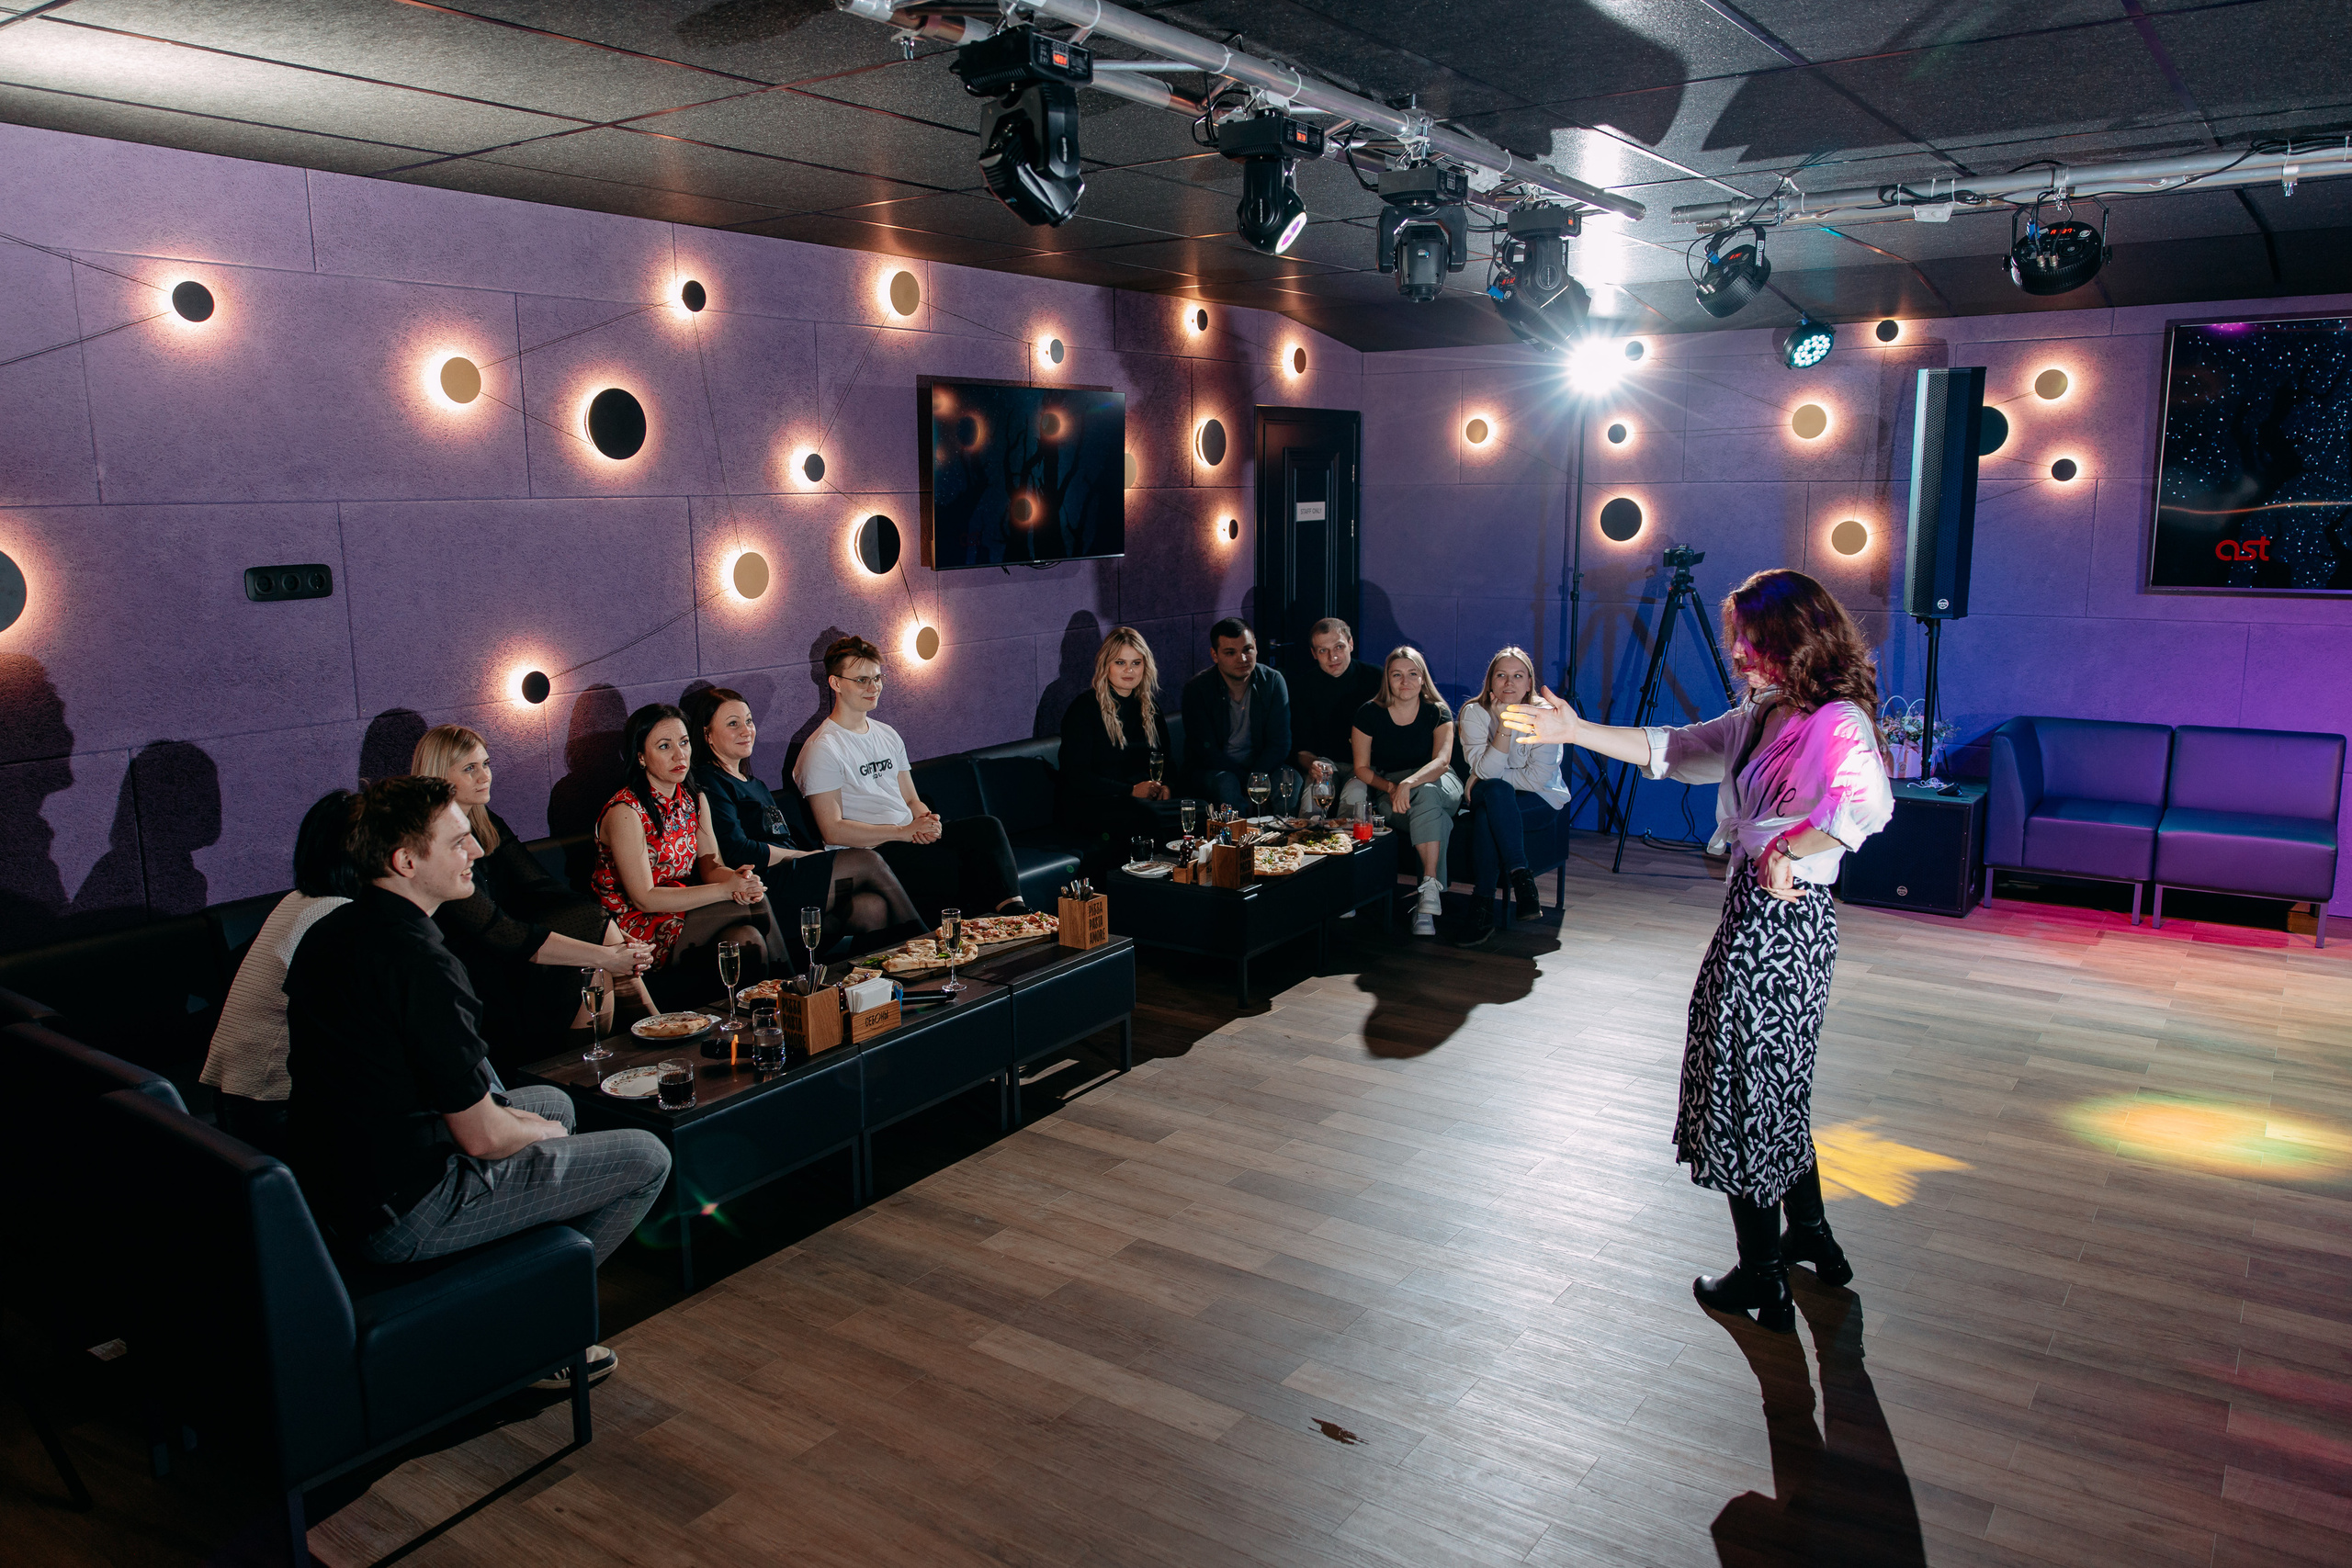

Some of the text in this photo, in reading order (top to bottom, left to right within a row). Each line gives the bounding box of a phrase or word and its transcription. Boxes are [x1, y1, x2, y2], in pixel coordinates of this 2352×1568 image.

[2215, 536, 2270, 561] ast
[1089, 915, 1103, 931] PASTA
[1089, 928, 1105, 944] AMORE
[782, 998, 802, 1016] PIZZA
[783, 1013, 803, 1032] PASTA
[865, 1010, 889, 1027] СЕЗОНЫ
